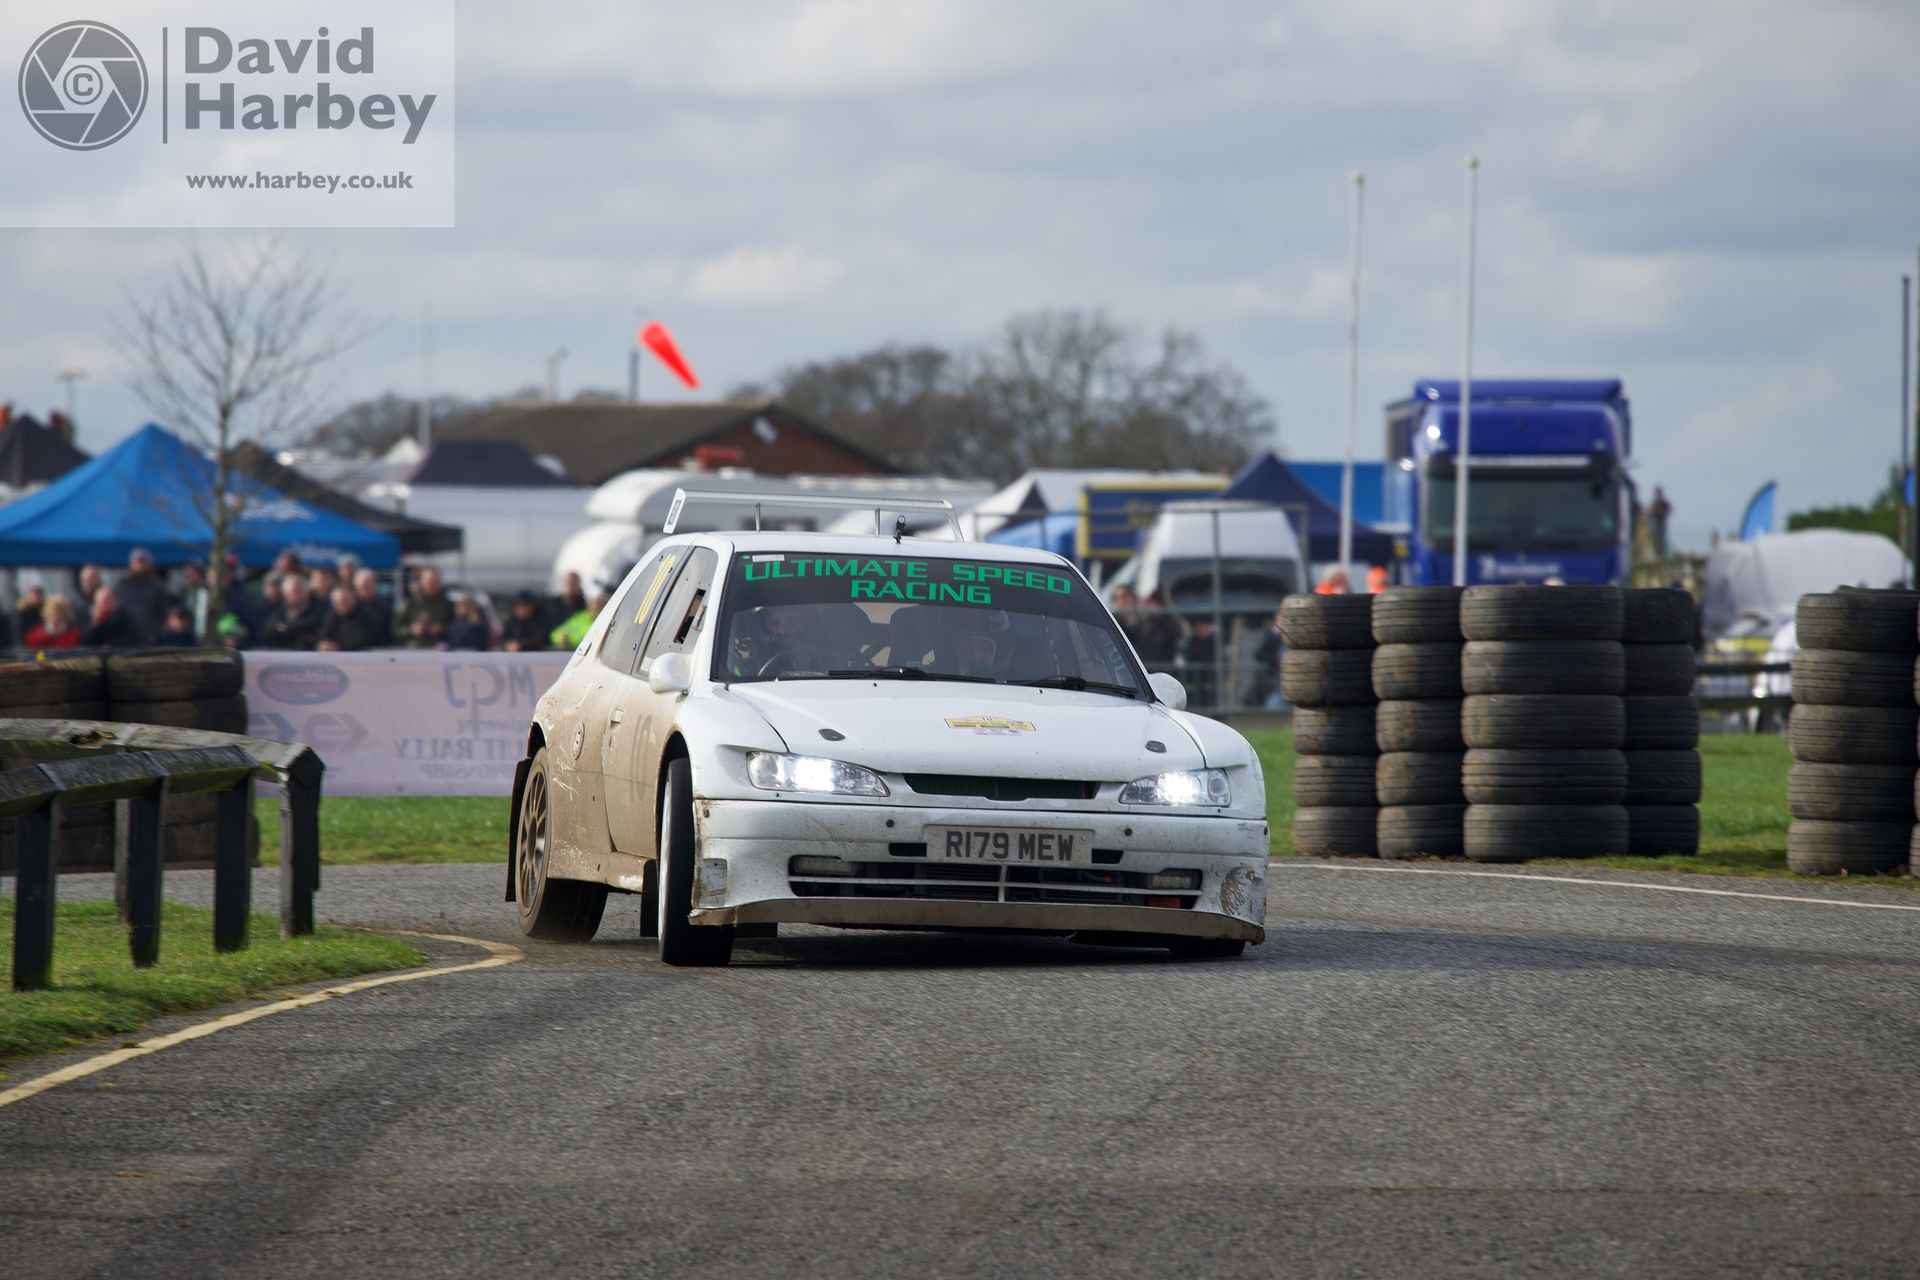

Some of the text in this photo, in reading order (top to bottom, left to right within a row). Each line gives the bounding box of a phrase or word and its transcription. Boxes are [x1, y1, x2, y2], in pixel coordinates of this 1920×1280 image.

[745, 557, 1071, 595] ULTIMATE SPEED
[850, 579, 992, 605] RACING
[945, 831, 1074, 861] R179 MEW
